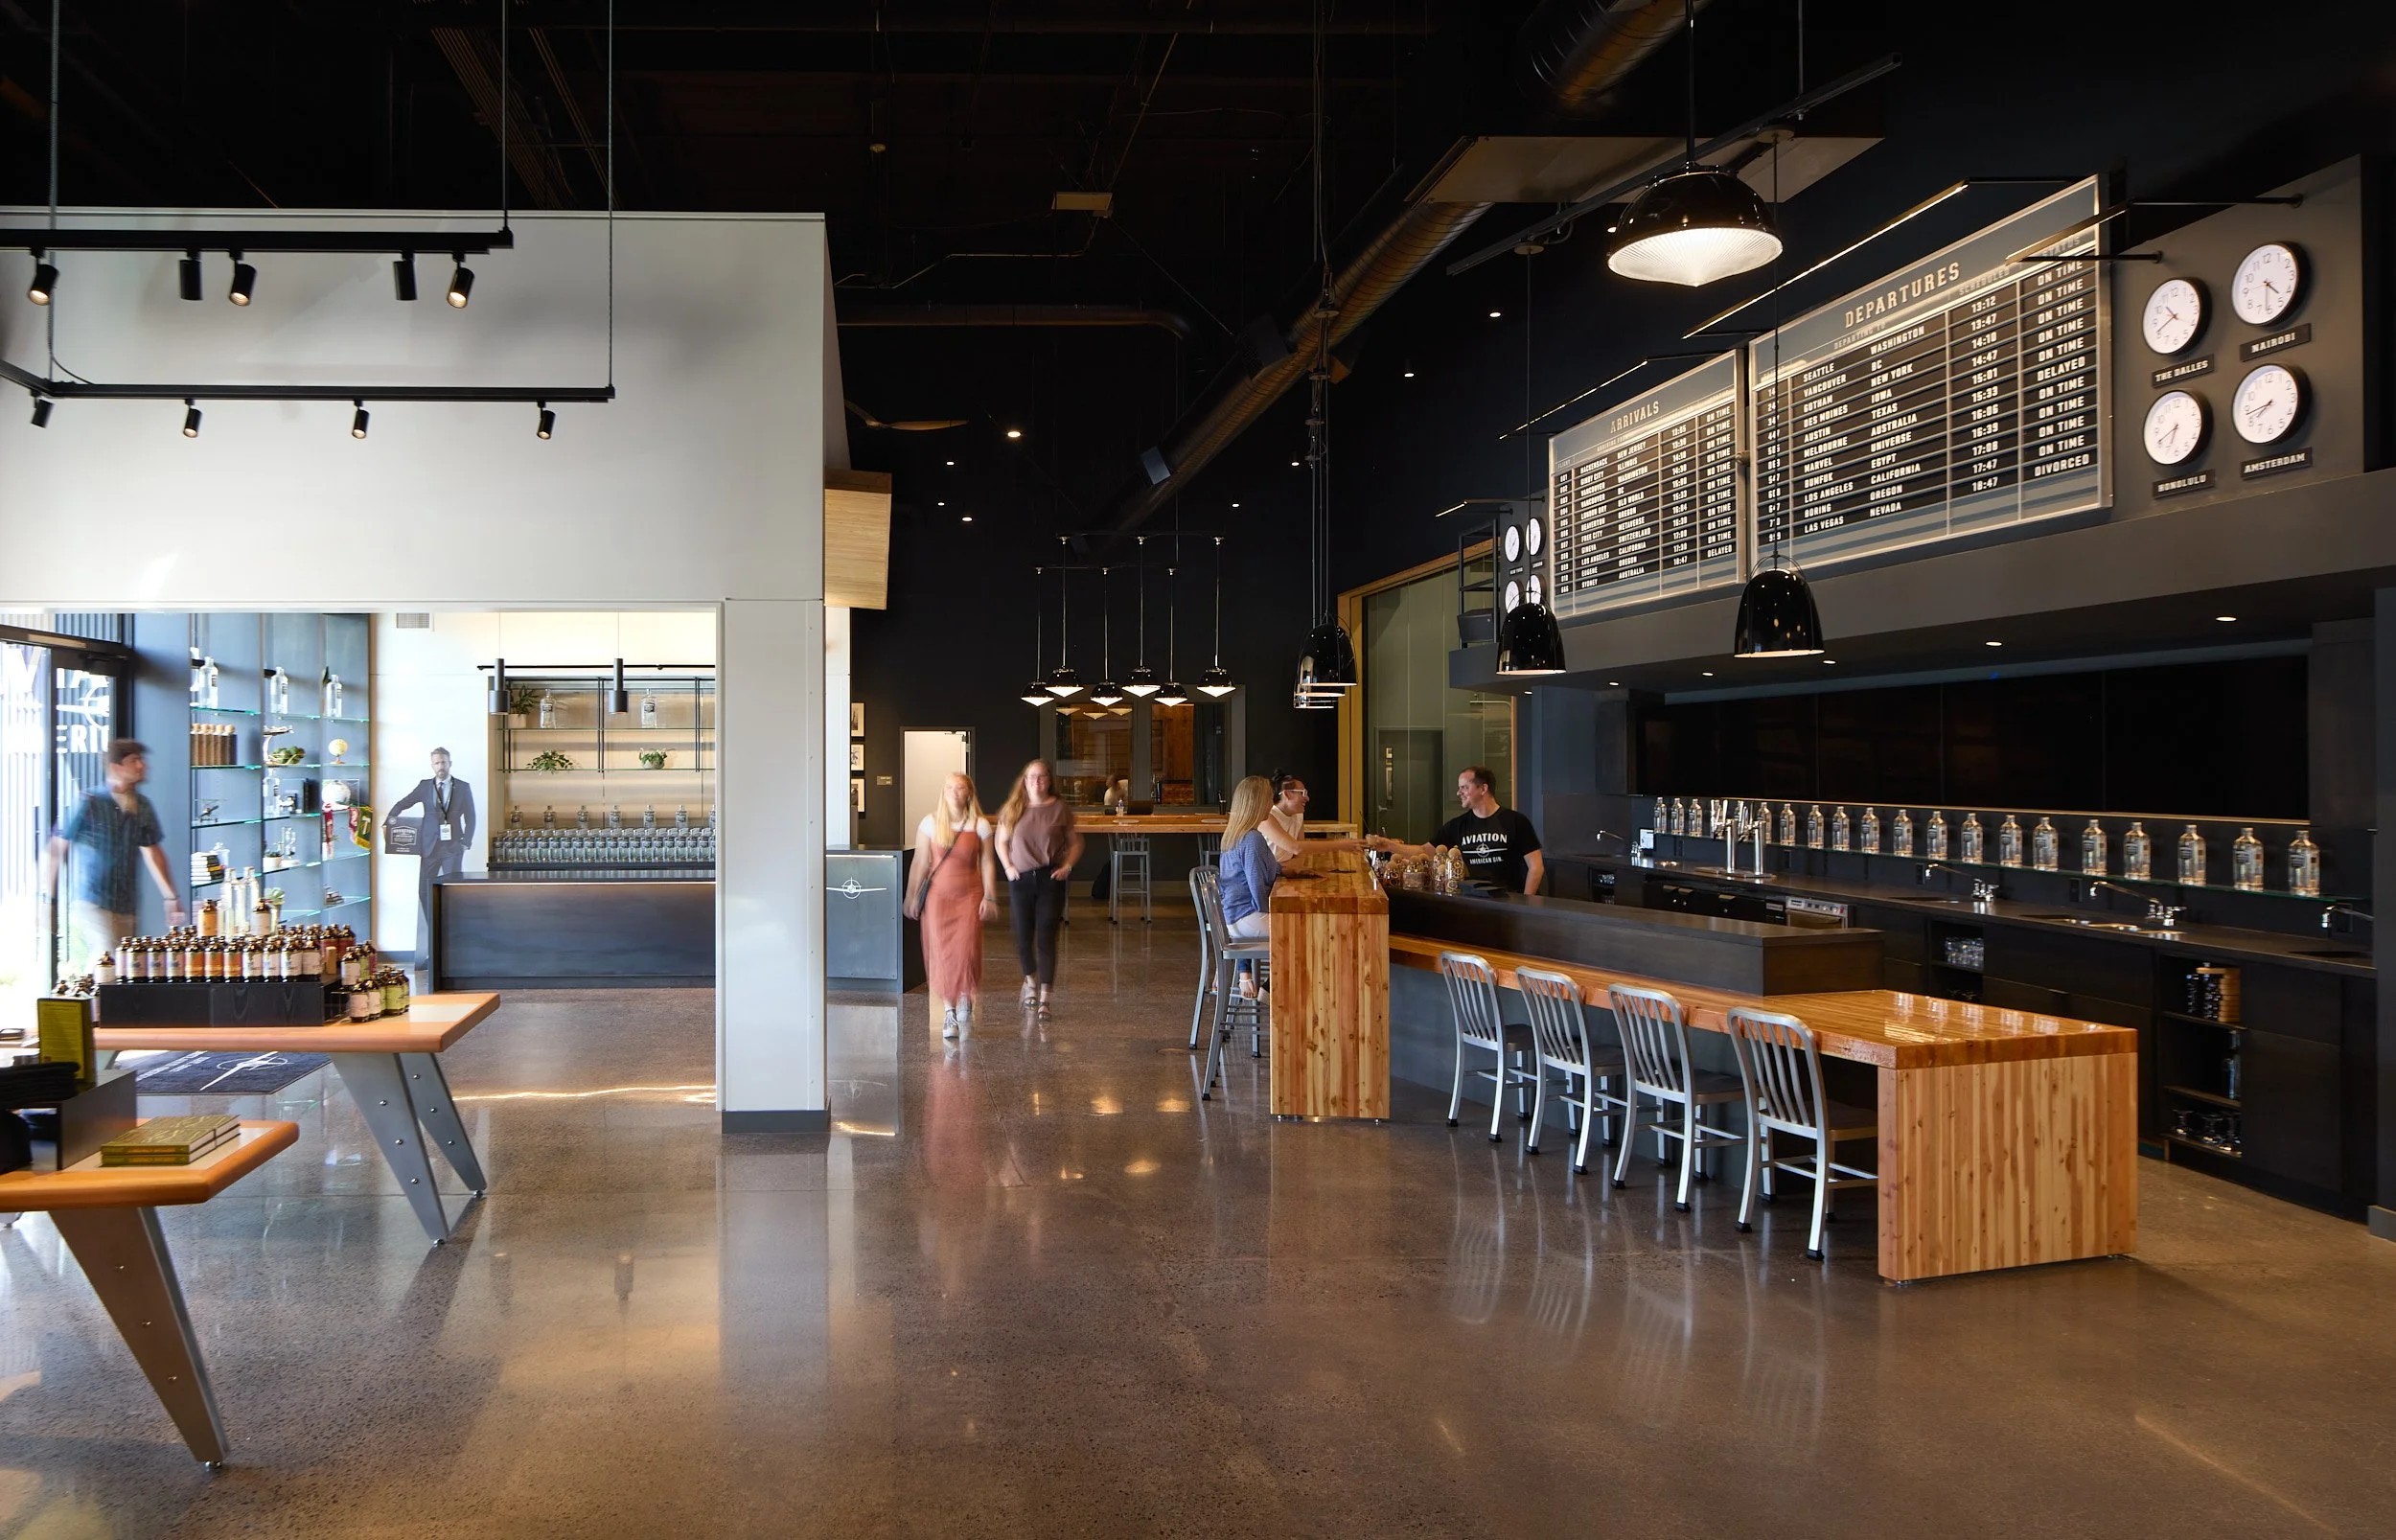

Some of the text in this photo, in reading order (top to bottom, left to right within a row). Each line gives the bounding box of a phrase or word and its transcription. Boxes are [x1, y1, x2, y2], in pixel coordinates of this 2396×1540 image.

[1804, 363, 1834, 382] SEATTLE
[1871, 326, 1924, 355] WASHINGTON
[1971, 296, 1995, 313] 13:12
[2038, 272, 2052, 286] ON
[2056, 262, 2083, 278] TIME
[1845, 262, 1960, 328] DEPARTURES
[1804, 375, 1846, 398] VANCOUVER
[1872, 359, 1882, 371] BC
[1971, 313, 1996, 331] 13:47
[2039, 291, 2052, 305] ON
[2057, 279, 2083, 297] TIME
[1804, 298, 2083, 413] GOTHAM NEW YORK 14:10 ON TIME
[1804, 318, 2084, 427] DES MOINES IOWA 14:47 ON TIME
[2154, 359, 2208, 382] THE DALLES
[2251, 332, 2296, 354] NAIROBI
[1610, 401, 1659, 433] ARRIVALS
[1805, 337, 2084, 443] AUSTIN TEXAS 15:01 ON TIME
[1805, 356, 2085, 458] MELBOURNE AUSTRALIA 15:33 DELAYED
[1805, 377, 2085, 473] MARVEL UNIVERSE 16:06 ON TIME
[1805, 416, 2085, 503] LOS ANGELES CALIFORNIA 17:08 ON TIME
[1872, 453, 1897, 469] EGYPT
[1972, 423, 1998, 438] 16:39
[2039, 405, 2053, 419] ON
[2058, 396, 2084, 413] TIME
[2244, 453, 2306, 473] AMSTERDAM
[1805, 435, 2085, 517] BORING OREGON 17:47 ON TIME
[1805, 454, 2089, 533] LAS VEGAS NEVADA 18:47 DIVORCED
[2157, 474, 2207, 493] HONOLULU
[1462, 833, 1508, 846] AVIATION
